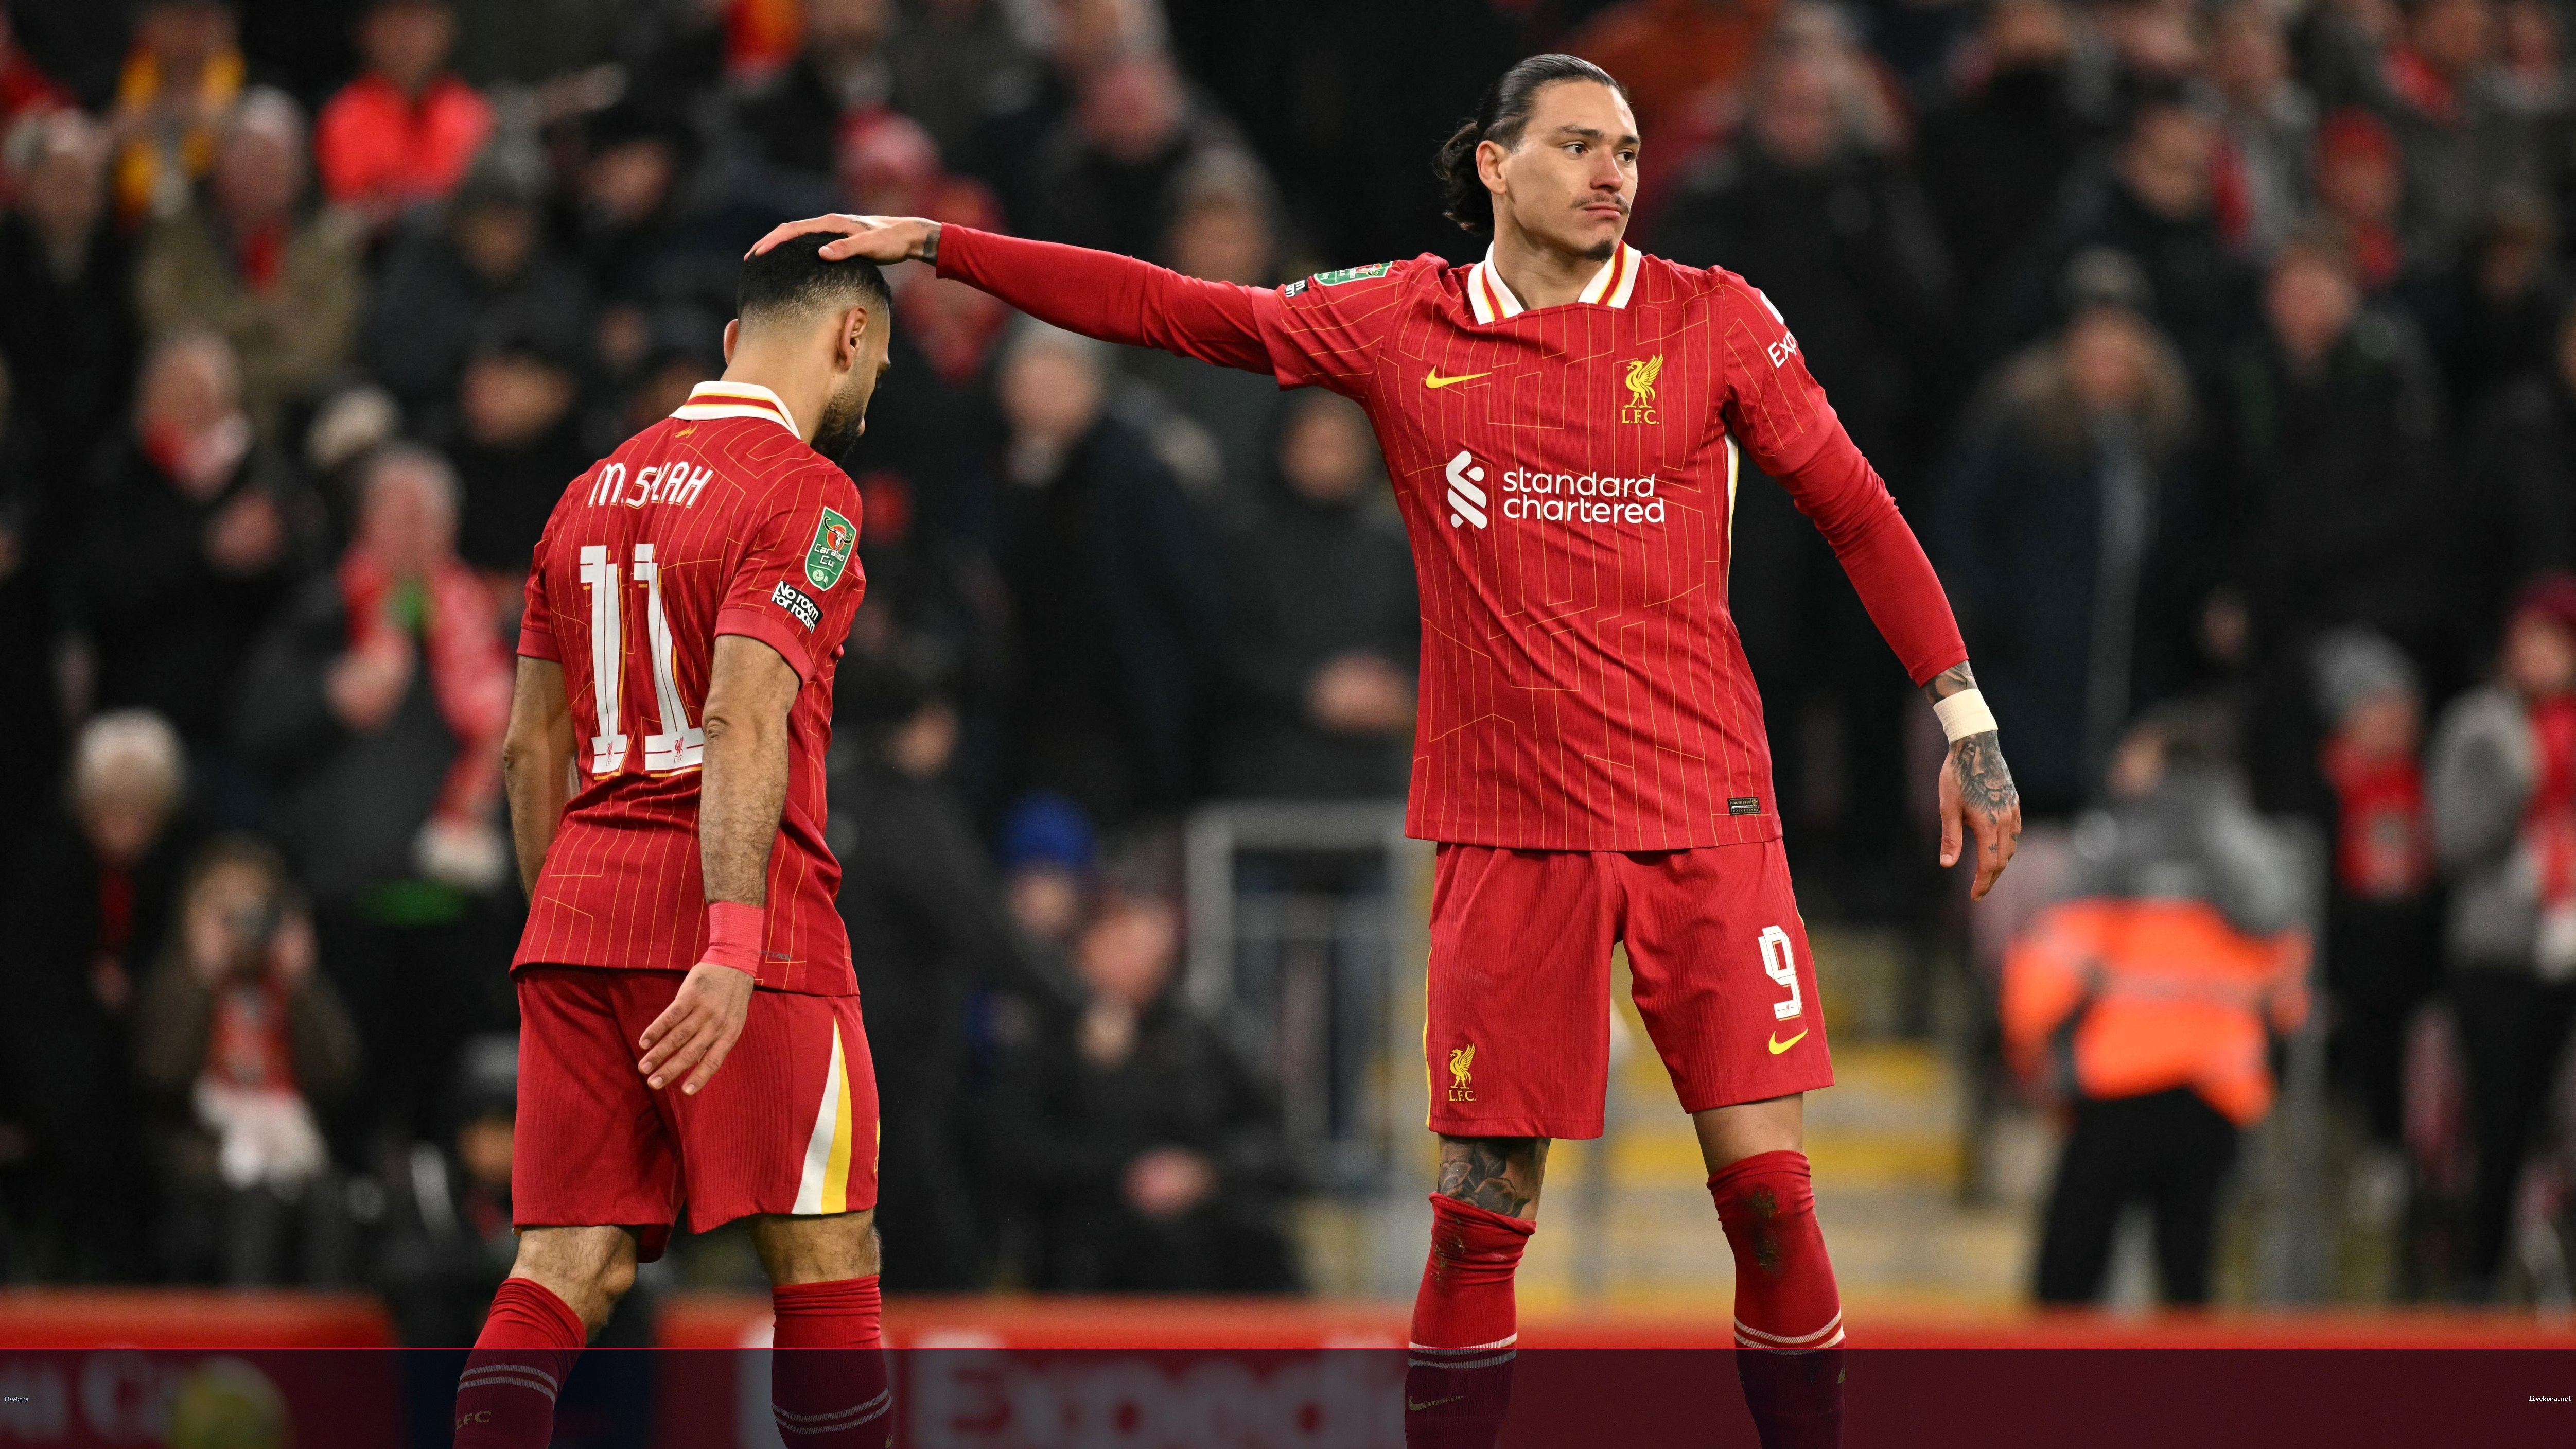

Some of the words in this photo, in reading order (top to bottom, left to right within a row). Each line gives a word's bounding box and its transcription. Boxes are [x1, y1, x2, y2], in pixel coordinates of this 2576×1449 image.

[1621, 409, 1660, 425] L.F.C.
[1503, 466, 1656, 497] standard
[1503, 493, 1665, 523] chartered
[771, 591, 793, 608] for
[775, 580, 796, 600] No
[796, 594, 819, 621] room
[580, 543, 704, 773] 11
[1758, 924, 1803, 1022] 9
[1448, 1089, 1476, 1102] L.F.C.
[456, 1411, 492, 1431] LFC
